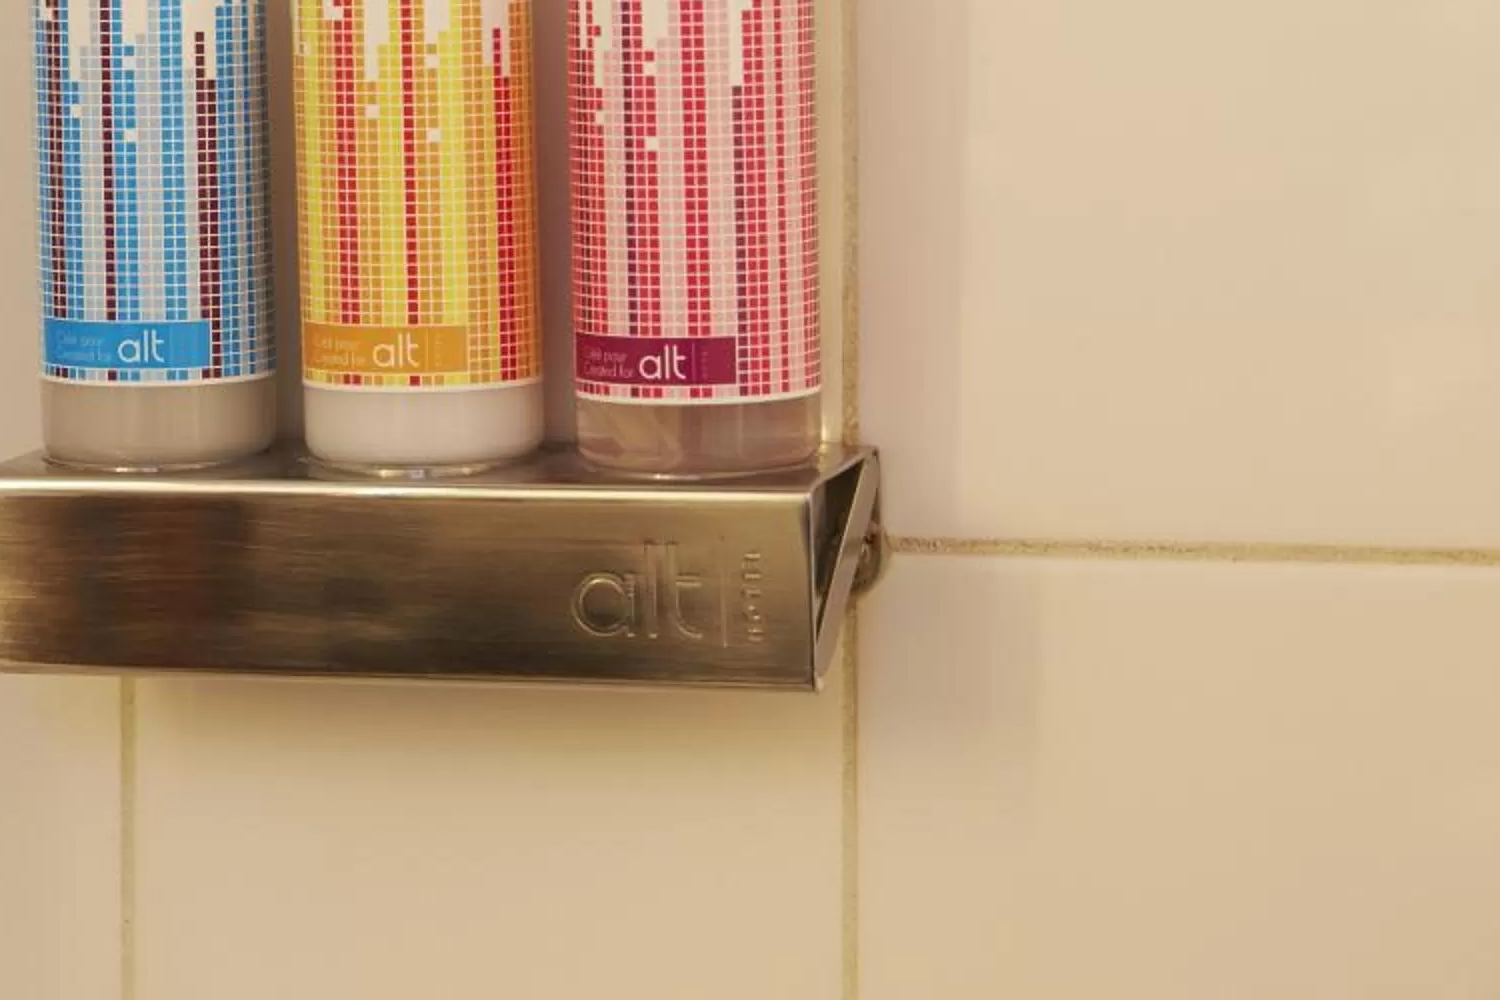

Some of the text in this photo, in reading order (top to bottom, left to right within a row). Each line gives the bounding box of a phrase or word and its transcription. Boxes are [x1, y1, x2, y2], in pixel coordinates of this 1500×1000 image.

[116, 329, 165, 363] alt
[371, 332, 420, 369] alt
[638, 343, 687, 380] alt
[570, 538, 704, 639] alt
